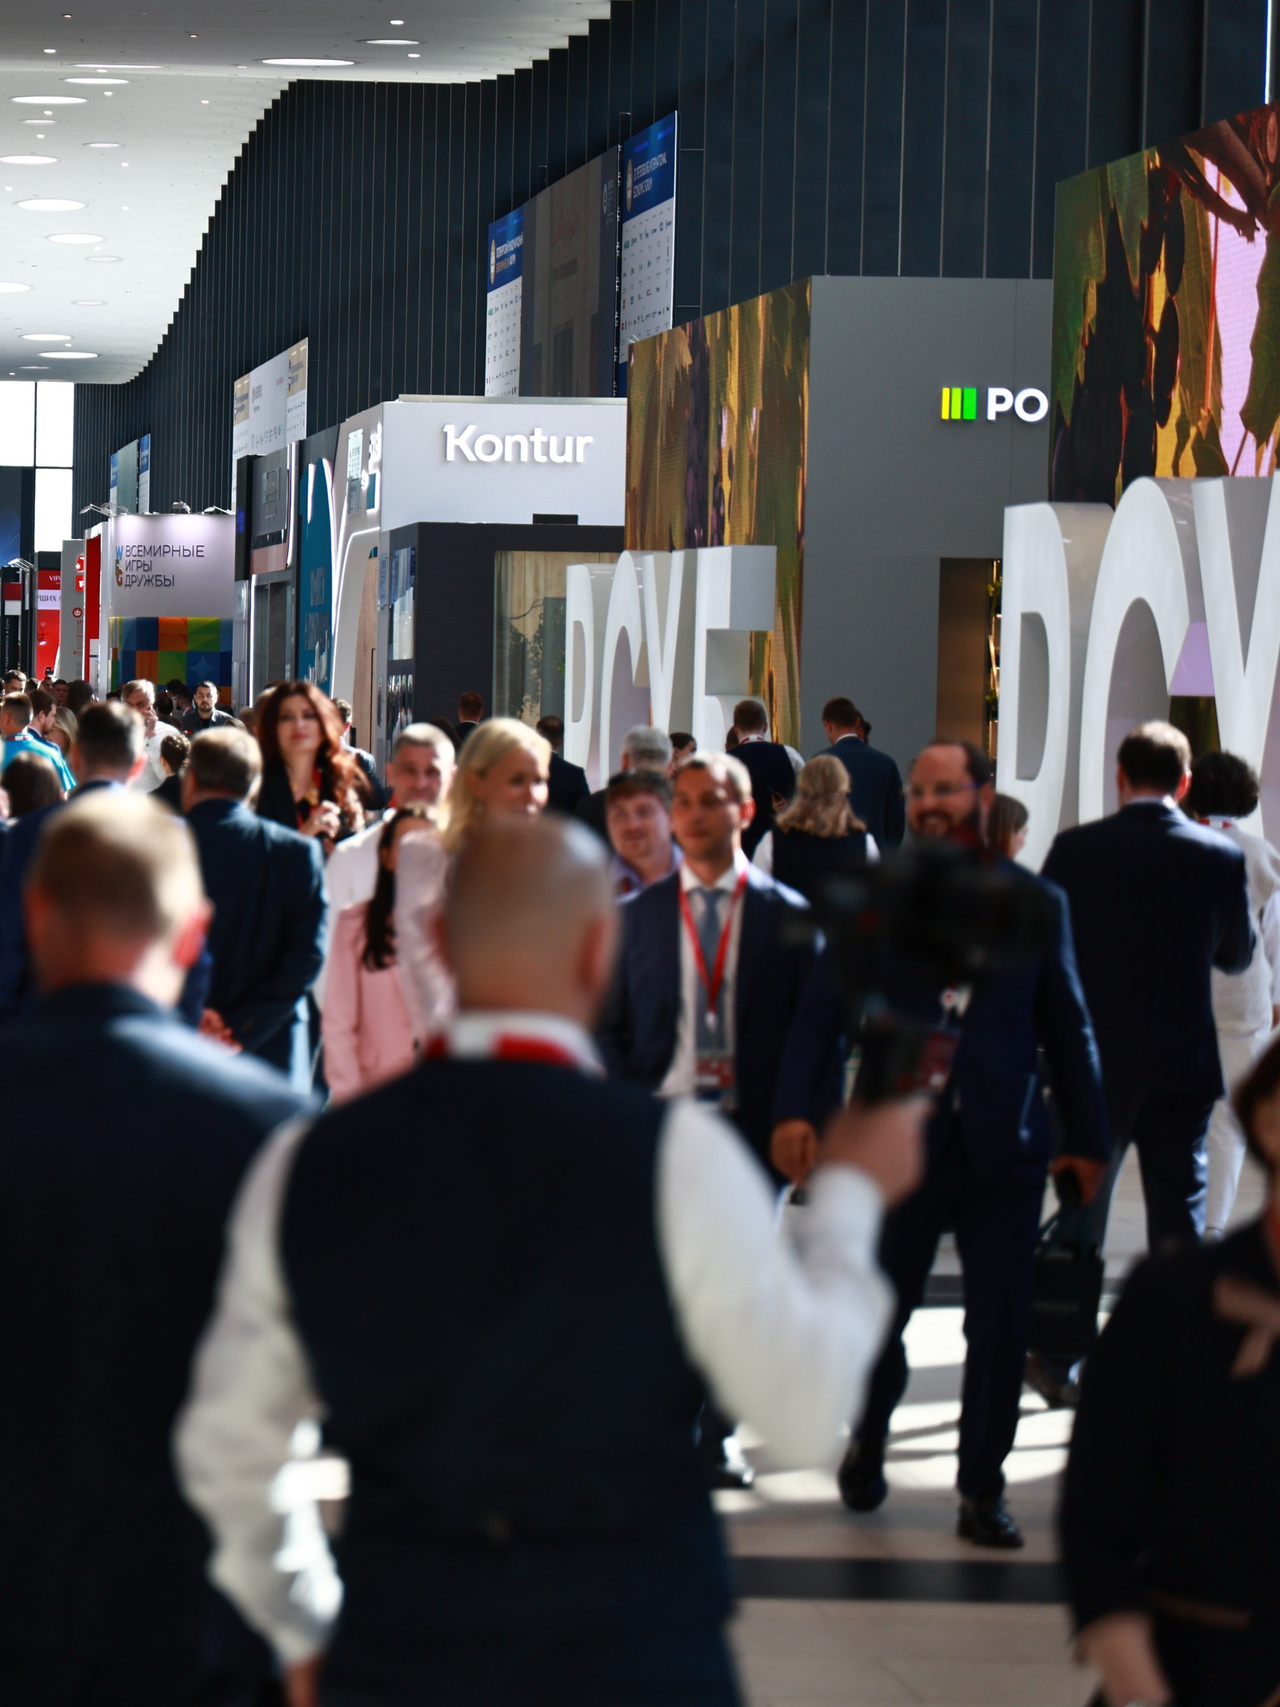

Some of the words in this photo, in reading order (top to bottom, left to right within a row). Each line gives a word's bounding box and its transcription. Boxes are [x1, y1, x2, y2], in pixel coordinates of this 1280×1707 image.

[443, 424, 594, 463] Kontur
[125, 545, 205, 558] ВСЕМИРНЫЕ
[125, 560, 153, 572] ИГРЫ
[124, 574, 175, 588] ДРУЖБЫ
